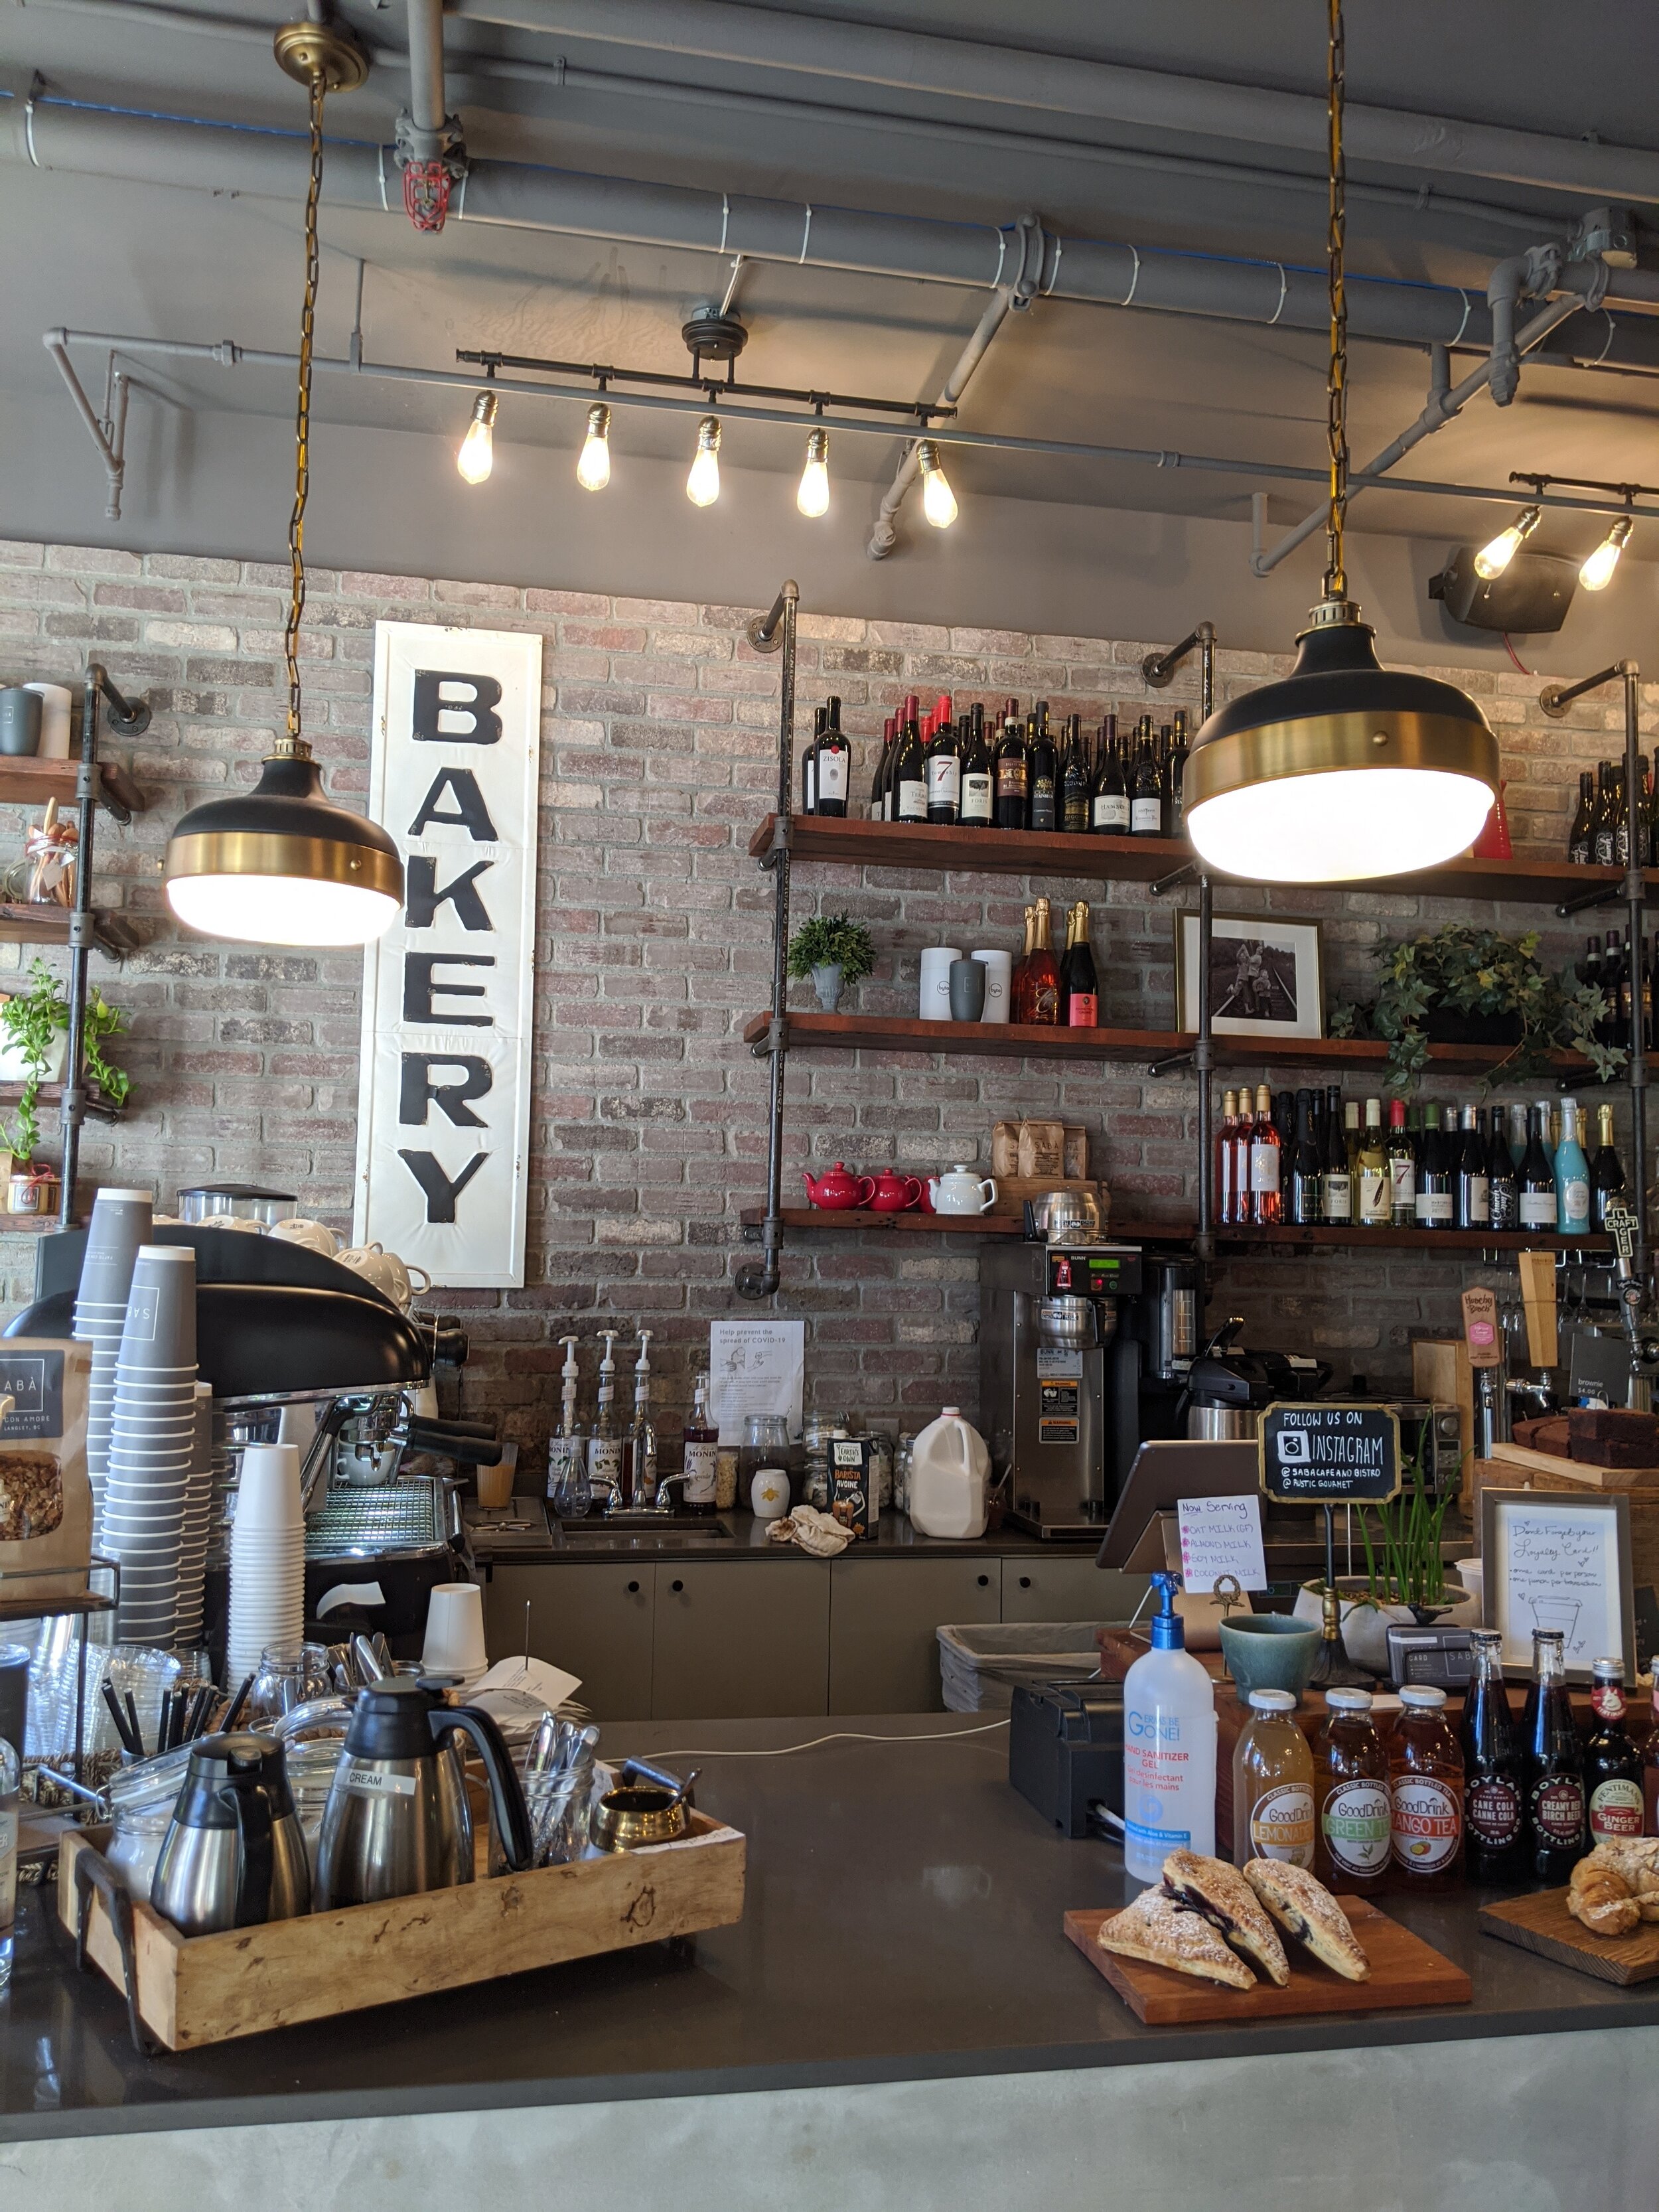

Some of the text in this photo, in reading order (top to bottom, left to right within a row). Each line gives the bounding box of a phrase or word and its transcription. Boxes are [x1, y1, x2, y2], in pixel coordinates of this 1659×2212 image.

[936, 761, 953, 782] 7
[398, 668, 504, 1224] BAKERY
[991, 984, 1002, 994] byta
[1395, 1164, 1411, 1185] 7
[1607, 1218, 1636, 1228] CRAFT
[127, 1305, 151, 1319] SAB
[4, 1377, 37, 1391] ABÀ
[1578, 1378, 1603, 1388] brownie
[1283, 1412, 1362, 1427] FOLLOW US ON
[1312, 1434, 1384, 1465] INSTAGRAM
[834, 1469, 861, 1481] BARISTA
[836, 1479, 858, 1489] AVOINE
[1318, 1480, 1353, 1489] GOURMET
[1183, 1501, 1248, 1519] Now Serving
[1189, 1526, 1206, 1534] OAT
[1545, 1525, 1575, 1540] Forget
[1576, 1530, 1595, 1541] your
[1190, 1539, 1252, 1549] ALMOND MILK
[1514, 1538, 1560, 1560] Loyalty
[1211, 1554, 1239, 1564] MILK
[1235, 1568, 1260, 1576] MILK
[1449, 1651, 1472, 1660] SAB
[1142, 1749, 1189, 1761] SANITIZER
[1141, 1758, 1159, 1769] GEL
[349, 1773, 382, 1786] CREAM
[1143, 1779, 1153, 1789] les
[1155, 1783, 1180, 1791] mains
[1266, 1787, 1290, 1801] CLASSIC
[1336, 1781, 1384, 1796] CLASSIC BOTTLED
[1415, 1778, 1442, 1791] BOTTLED
[1442, 1789, 1452, 1799] TEA
[1531, 1777, 1584, 1801] BOYLA
[1597, 1784, 1640, 1805] FENTIMANS
[1338, 1799, 1388, 1817] GoodDrink
[1394, 1796, 1449, 1815] GoodDrink
[1473, 1799, 1514, 1811] CANE COLA
[1542, 1800, 1570, 1811] CREAMY
[1473, 1808, 1514, 1821] CANNE COLA
[1542, 1810, 1565, 1820] BIRCH
[1597, 1812, 1640, 1824] GINGER
[1326, 1818, 1374, 1837] GREEN
[1394, 1814, 1457, 1835] ANGO TEA
[1603, 1821, 1635, 1832] BEER
